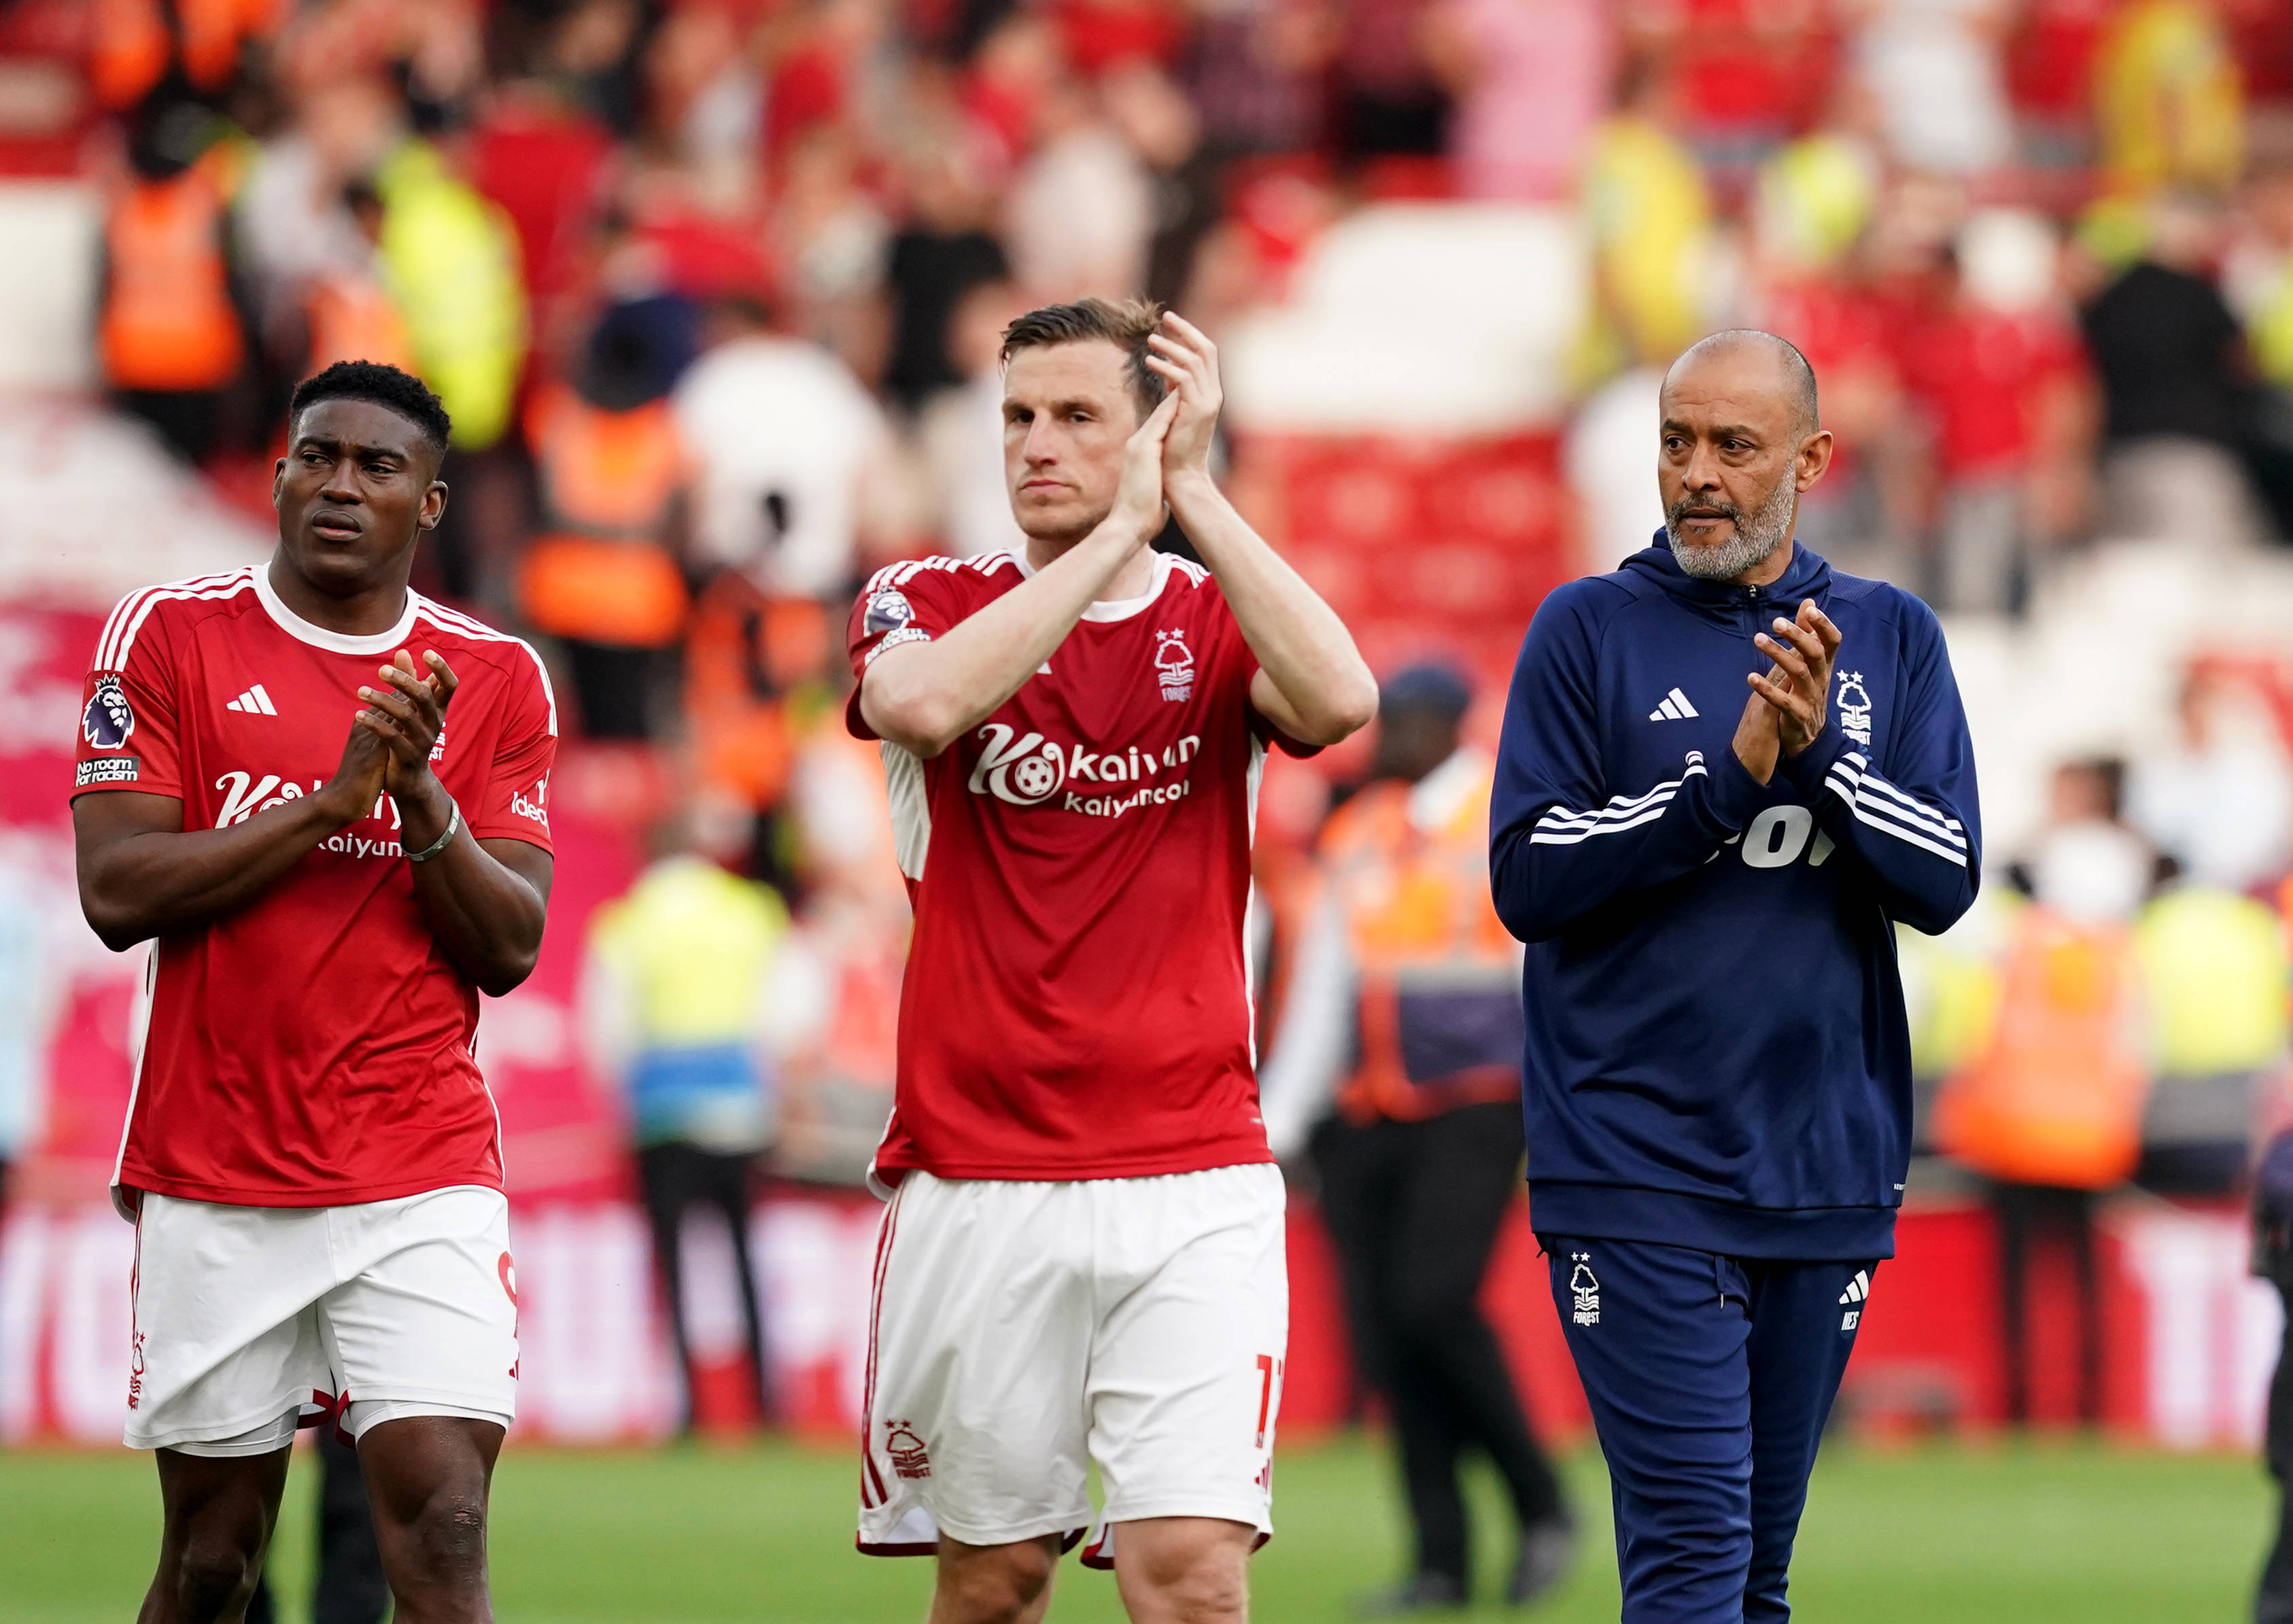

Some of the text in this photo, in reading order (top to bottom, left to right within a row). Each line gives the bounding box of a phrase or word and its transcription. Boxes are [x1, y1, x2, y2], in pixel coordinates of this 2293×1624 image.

[77, 759, 133, 775] No room
[75, 770, 138, 787] for racism
